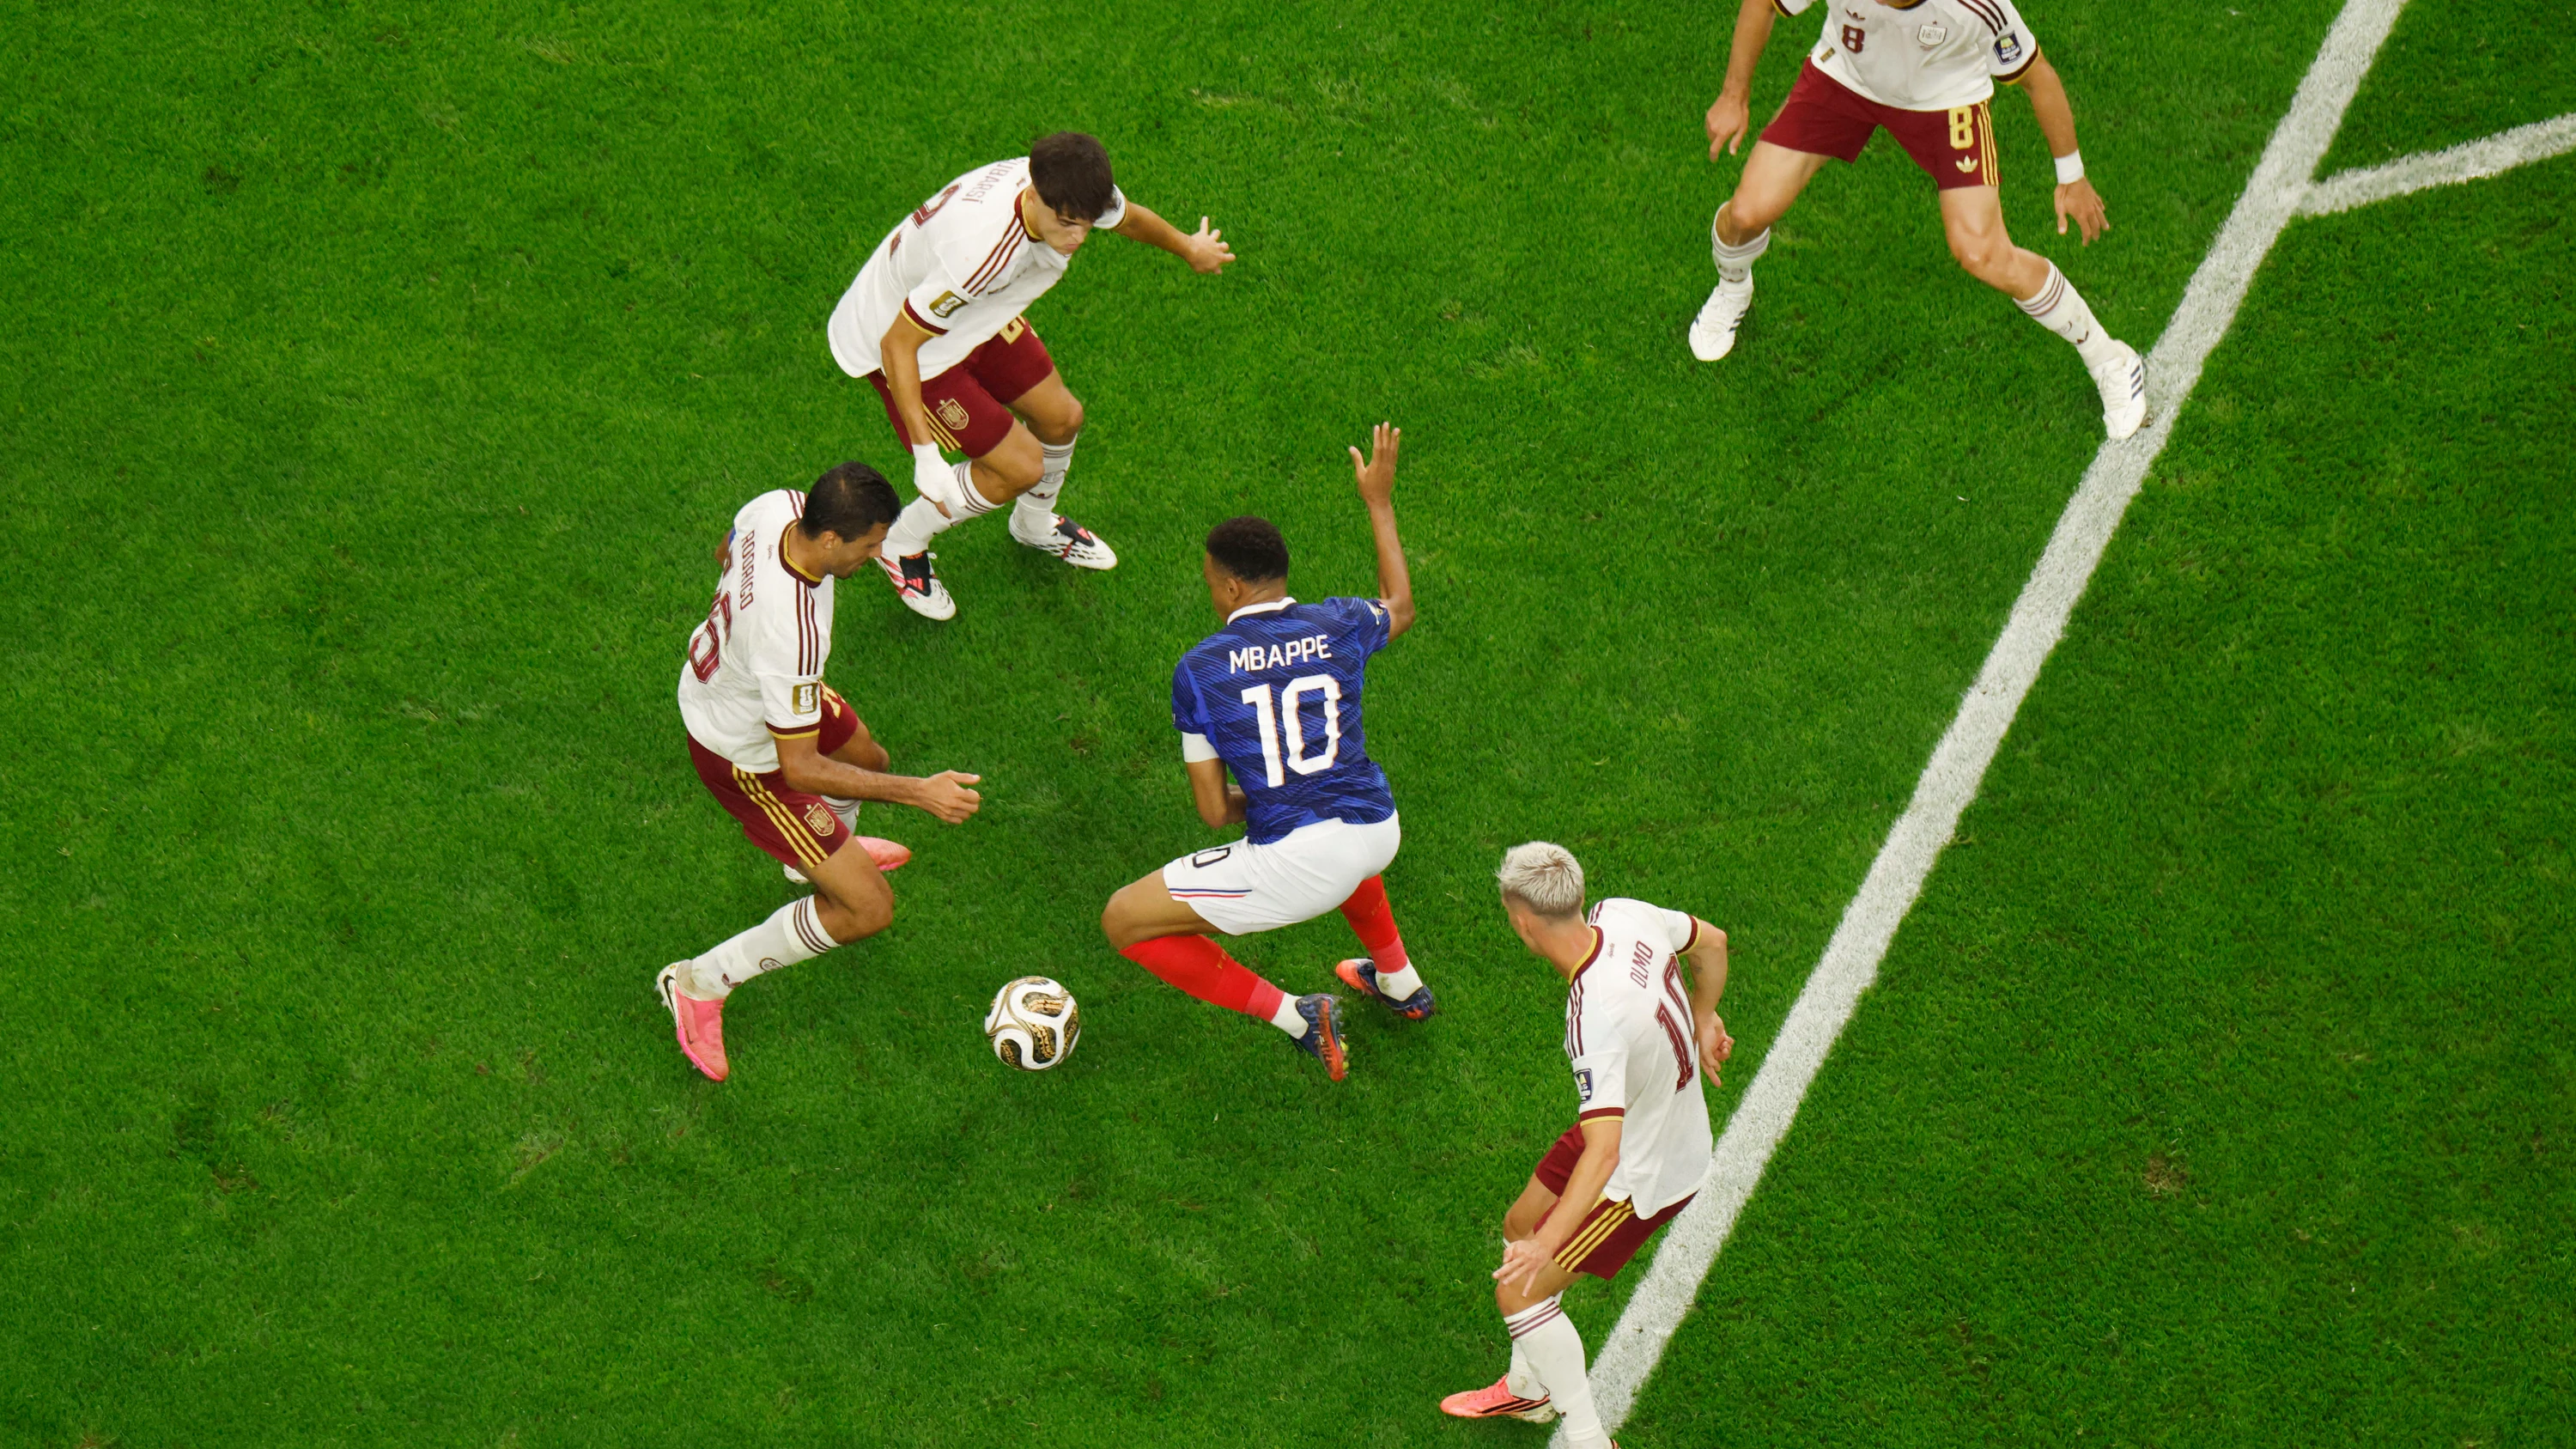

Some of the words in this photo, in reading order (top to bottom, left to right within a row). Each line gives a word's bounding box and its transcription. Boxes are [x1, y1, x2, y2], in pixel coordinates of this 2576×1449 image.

[1841, 23, 1866, 54] 8
[1947, 106, 1974, 150] 8
[739, 529, 756, 612] RODRIGO
[1229, 635, 1332, 673] MBAPPE
[1241, 673, 1342, 788] 10
[1630, 940, 1654, 989] OLMO
